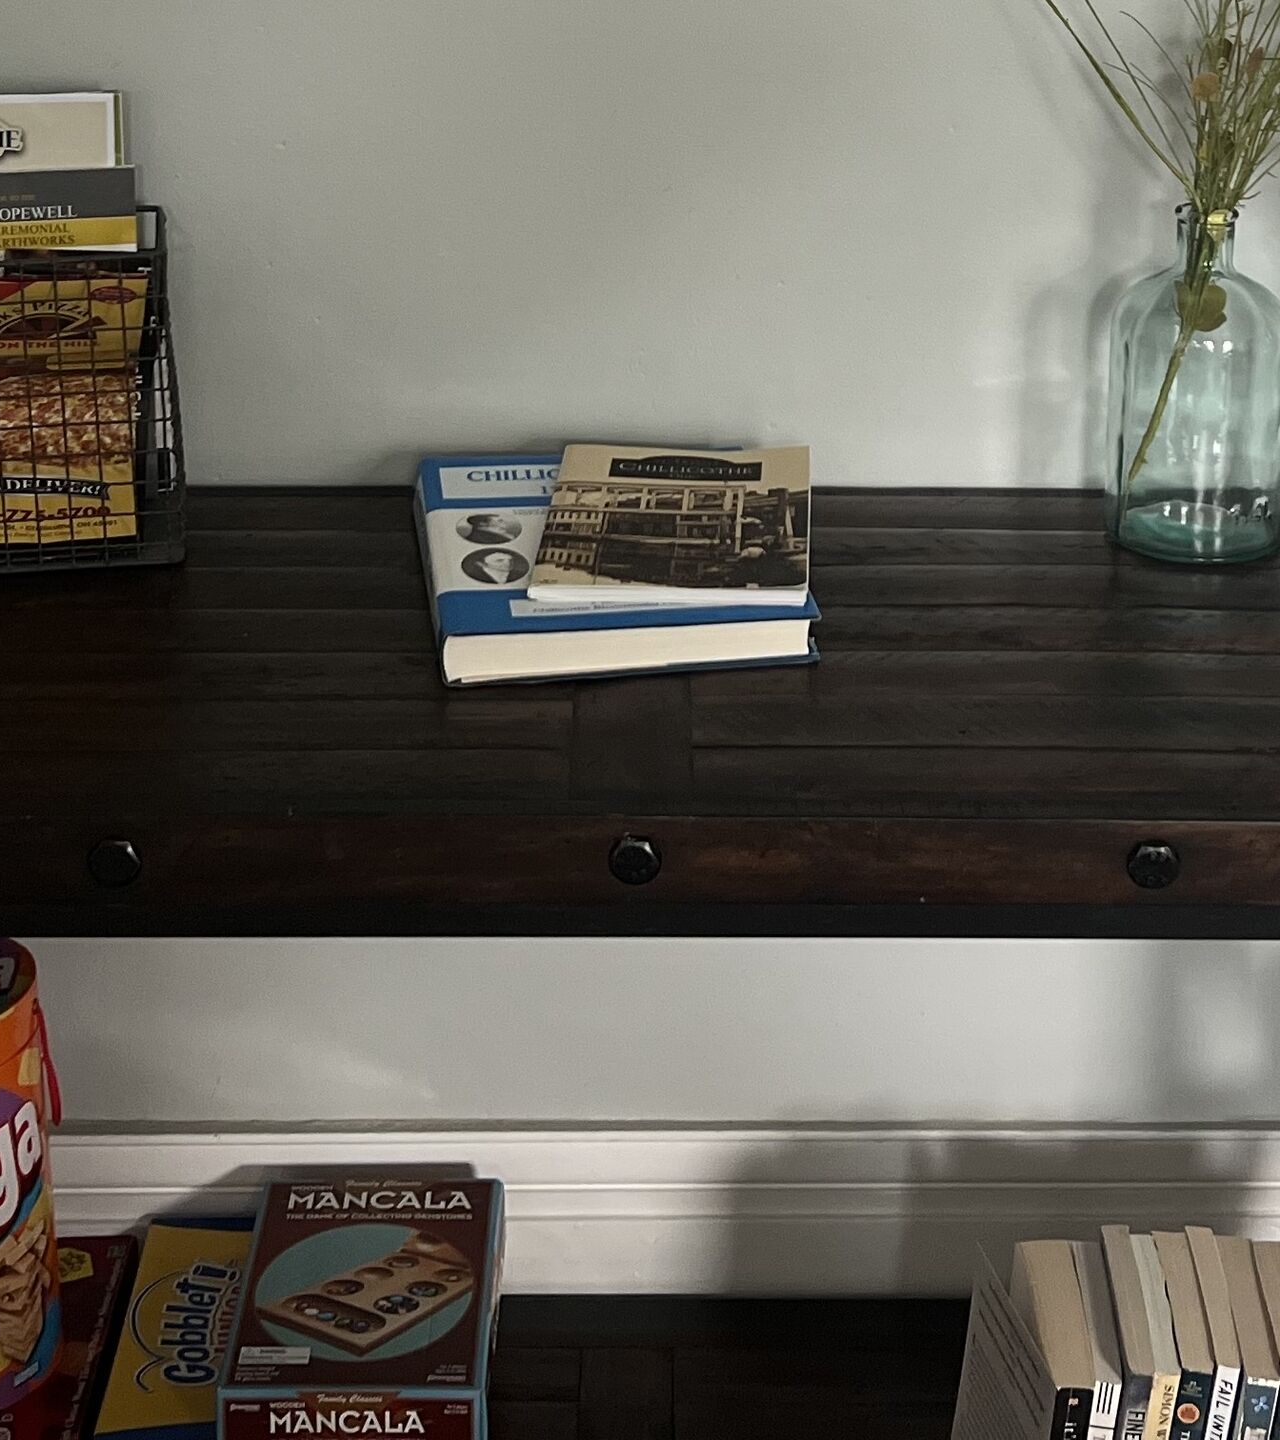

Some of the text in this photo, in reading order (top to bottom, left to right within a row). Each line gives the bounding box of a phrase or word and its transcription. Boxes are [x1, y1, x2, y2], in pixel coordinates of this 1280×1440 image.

[618, 459, 754, 476] CHILLICOTHE
[6, 478, 101, 495] DELIVER!
[287, 1191, 472, 1210] MANCALA
[160, 1263, 240, 1386] Gobblet!
[1161, 1384, 1175, 1427] SIMON
[1208, 1379, 1233, 1440] FAIL UNT
[270, 1410, 425, 1435] MANCALA
